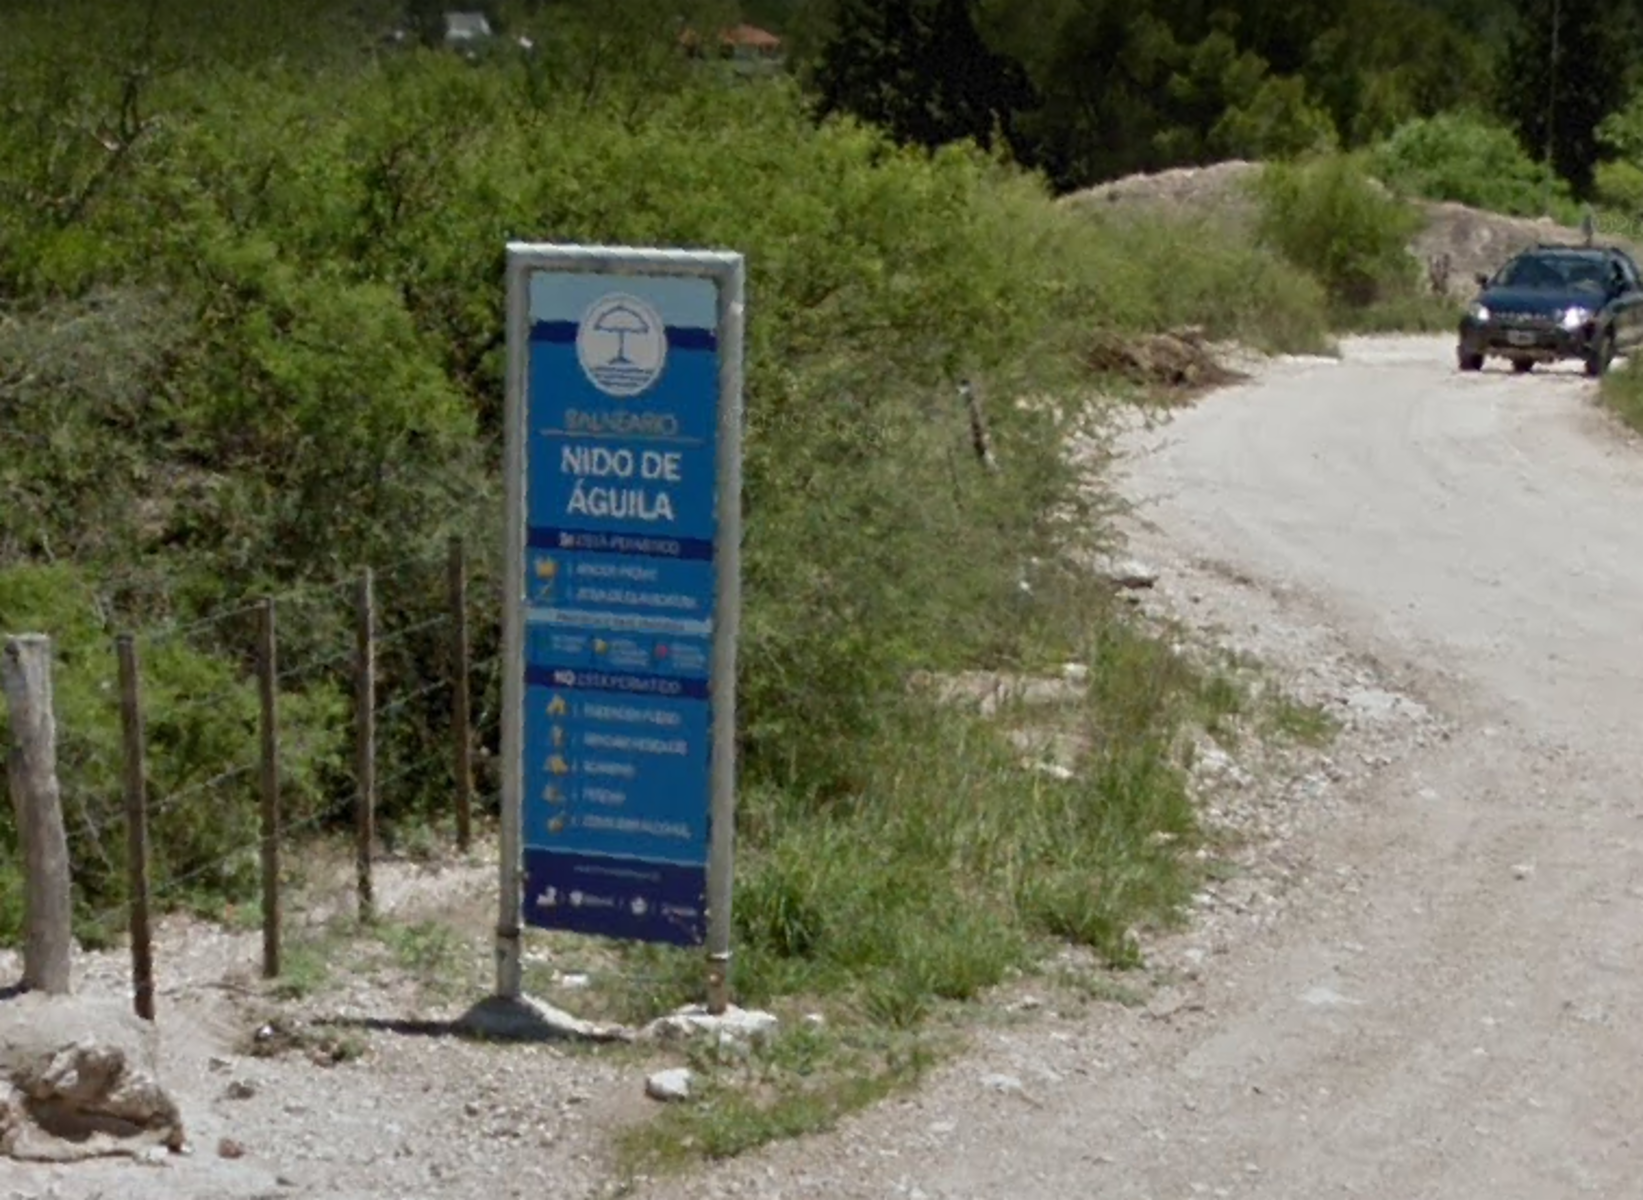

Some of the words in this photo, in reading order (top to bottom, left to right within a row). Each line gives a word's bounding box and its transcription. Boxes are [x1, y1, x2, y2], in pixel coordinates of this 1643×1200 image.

[564, 407, 679, 436] BALNEARIO
[560, 445, 633, 477] NIDO
[641, 451, 682, 481] DE
[566, 478, 674, 521] ÁGUILA
[553, 669, 576, 686] NO
